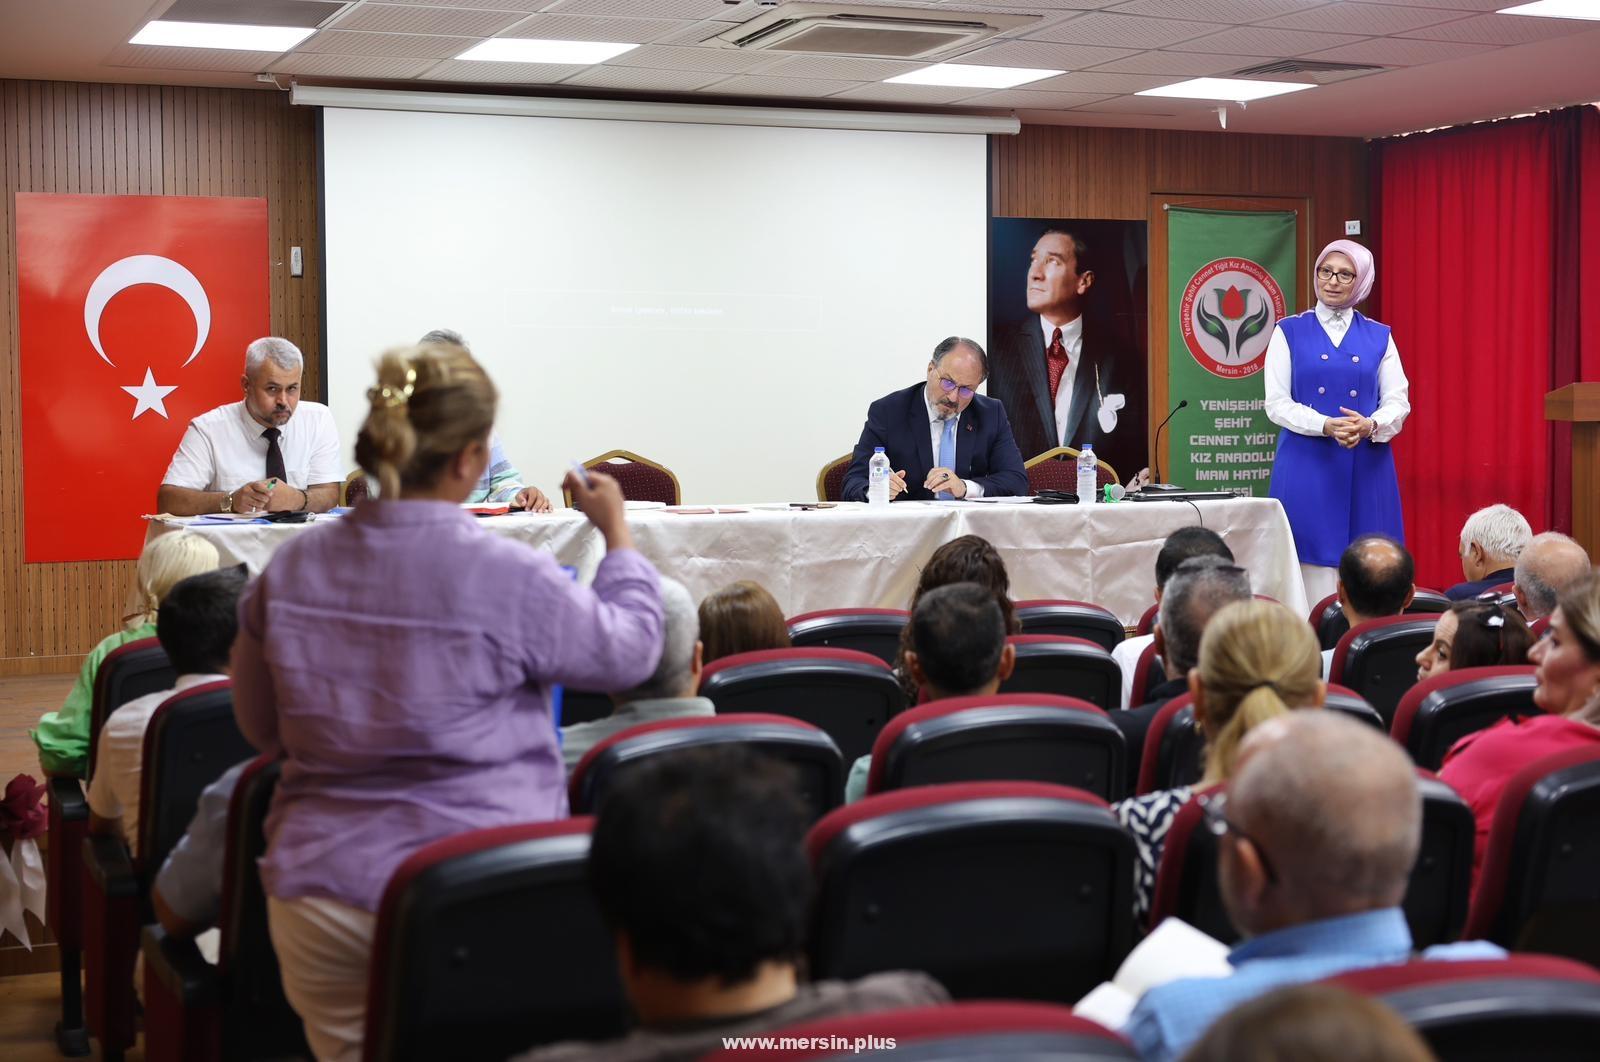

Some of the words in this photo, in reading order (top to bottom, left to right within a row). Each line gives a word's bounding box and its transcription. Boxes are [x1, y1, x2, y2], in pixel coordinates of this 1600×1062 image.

[1193, 268, 1214, 285] Cennet
[1185, 284, 1197, 302] Şehit
[1183, 302, 1191, 337] Yenişehir
[1216, 364, 1238, 374] Mersin
[1214, 416, 1252, 431] ŞEHİT
[1189, 435, 1240, 446] CENNET
[1244, 433, 1276, 445] YİĞİT
[1190, 452, 1212, 463] KIZ
[1216, 451, 1275, 463] ANADOLU
[1195, 467, 1229, 481] İMAM
[1233, 467, 1270, 480] HATİP
